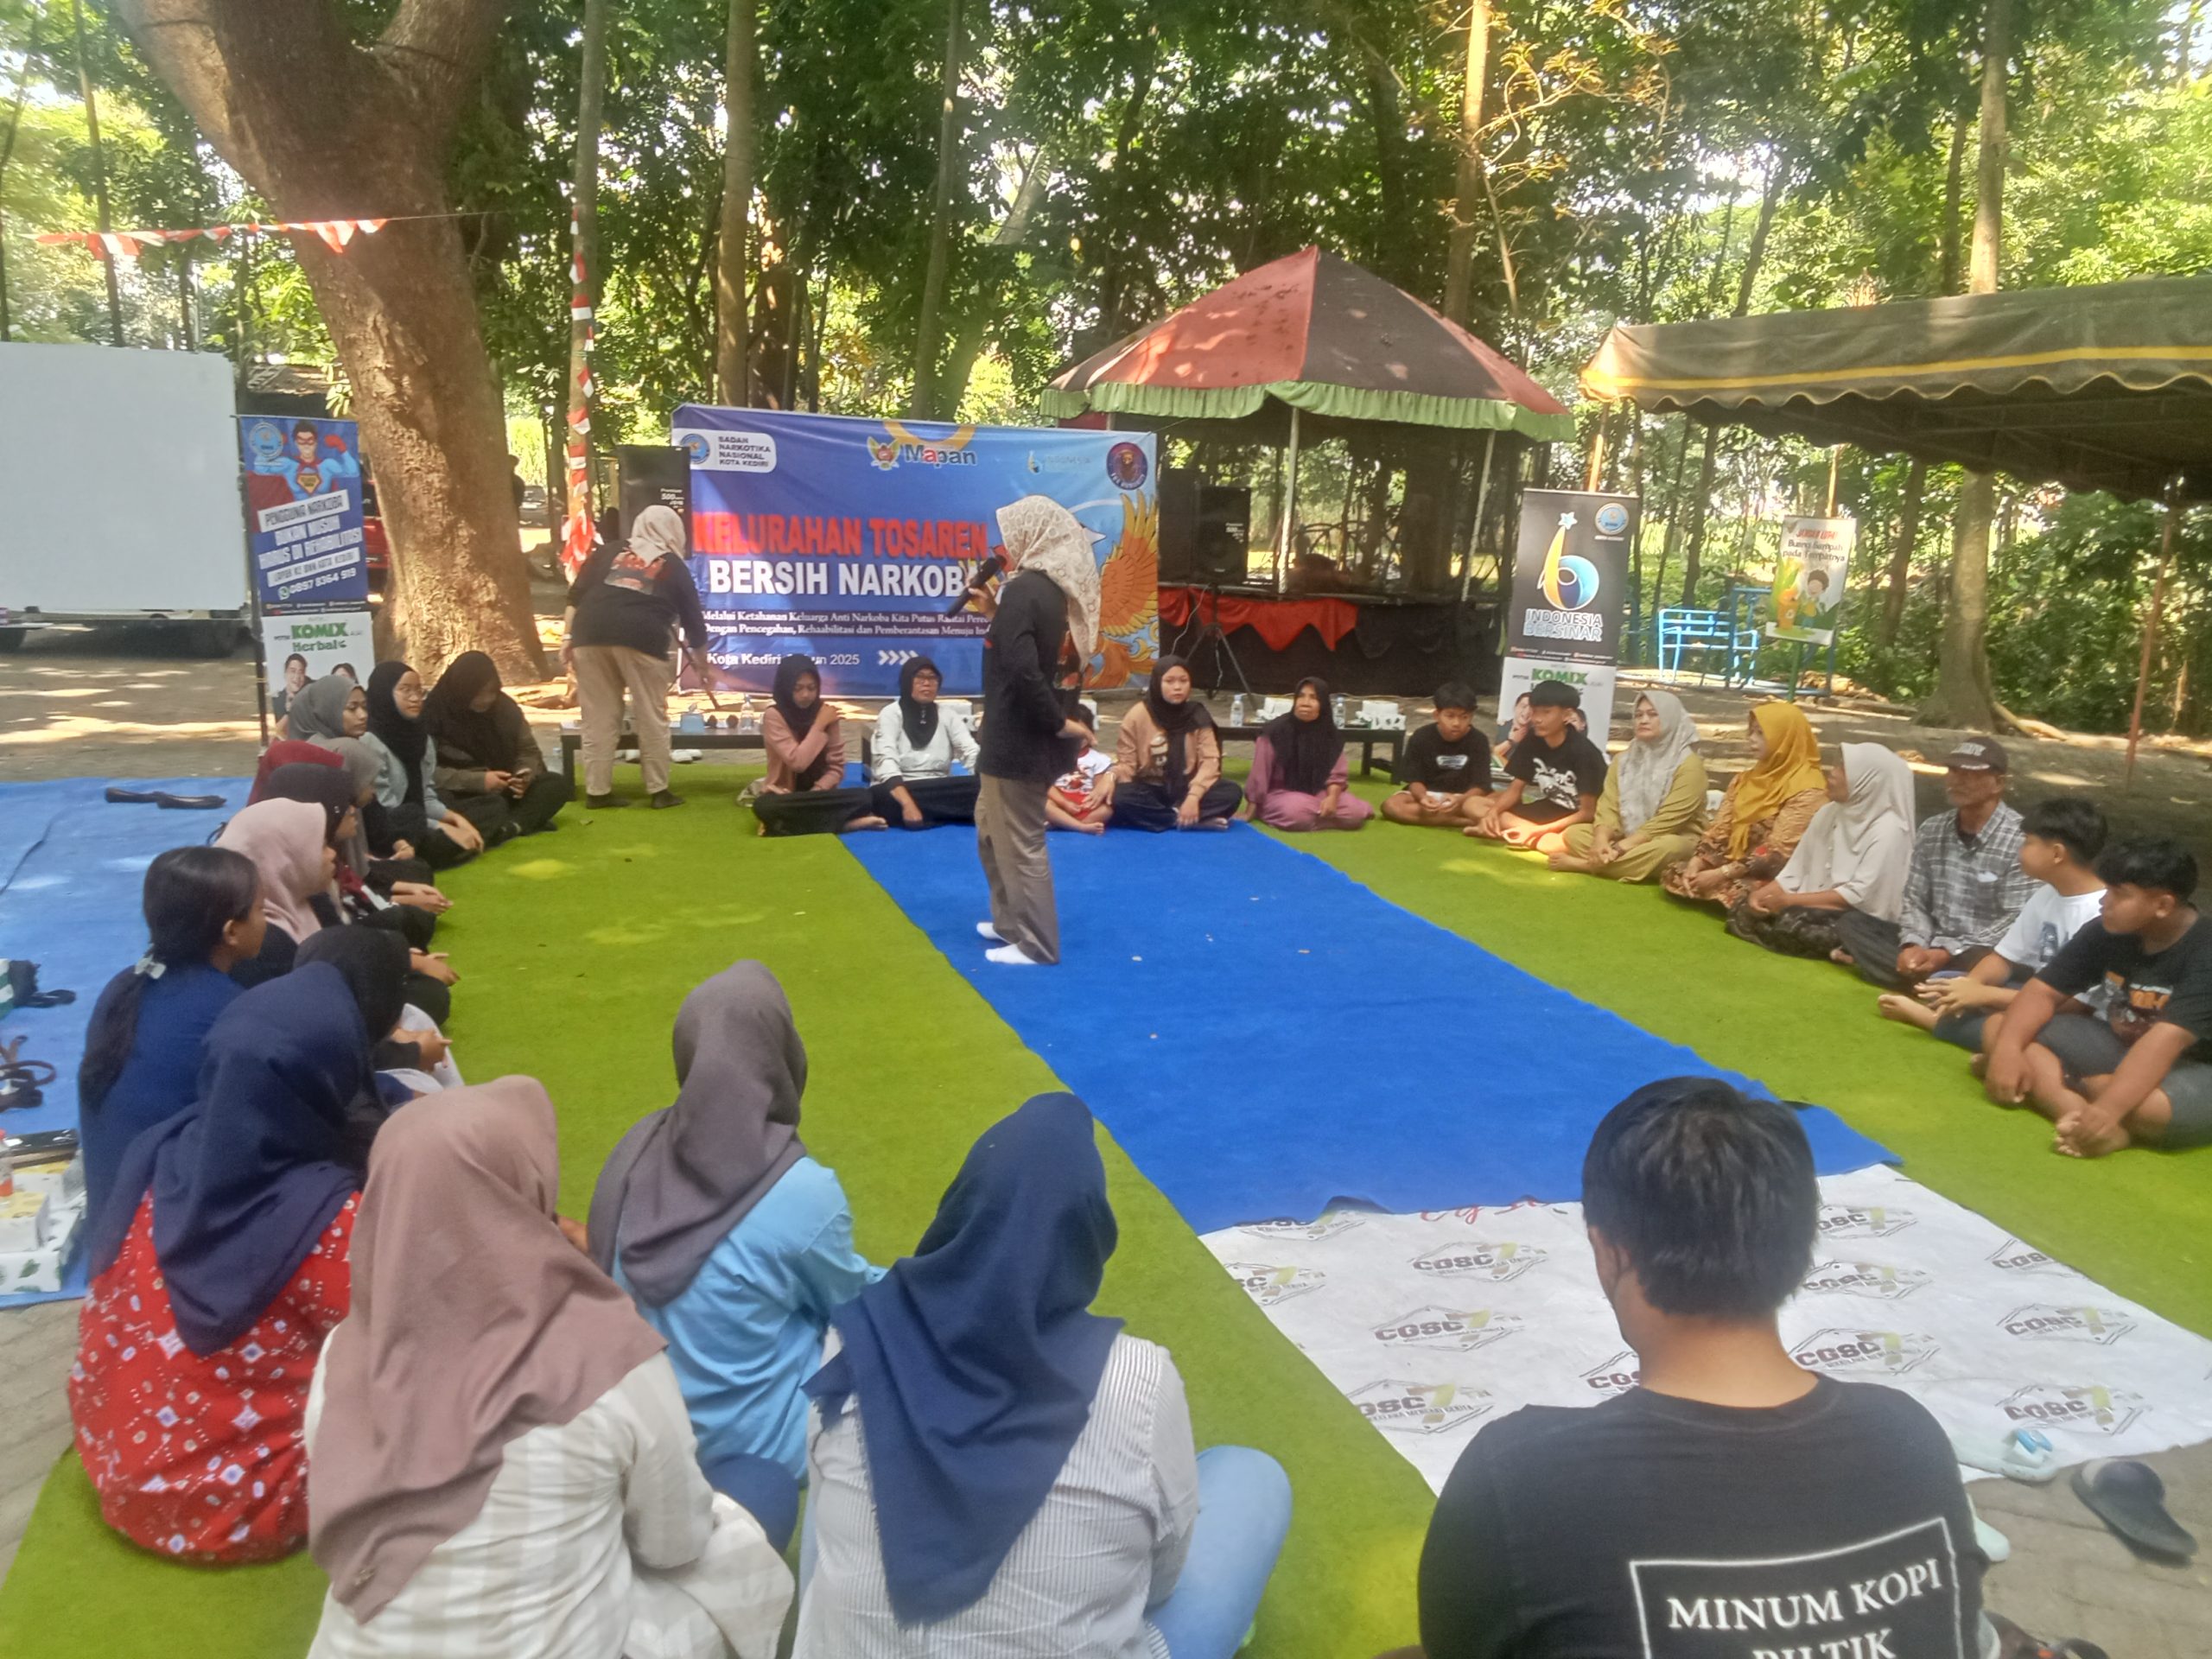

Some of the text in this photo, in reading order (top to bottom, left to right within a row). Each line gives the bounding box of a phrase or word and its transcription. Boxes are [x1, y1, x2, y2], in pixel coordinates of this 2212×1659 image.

[719, 444, 771, 453] NARKOTIKA
[906, 444, 977, 467] Mapan
[693, 512, 988, 560] KELURAHAN TOSAREN
[709, 560, 828, 594] BERSIH
[738, 611, 787, 620] Ketahanan
[789, 612, 829, 622] Keluarga
[830, 613, 850, 621] Anti
[852, 613, 889, 622] Narkoba
[892, 613, 909, 622] Kita
[912, 614, 935, 623] Putus
[1525, 608, 1604, 627] INDONESIA
[291, 622, 349, 639] KOMIX
[856, 626, 872, 634] dan
[874, 626, 939, 635] Pemberantasan
[941, 626, 974, 636] Menuju
[1522, 622, 1602, 642] BERSINAR
[292, 639, 338, 652] Herbal
[707, 653, 738, 664] Kota
[741, 653, 782, 664] Kediri
[830, 654, 860, 664] 2025
[1532, 668, 1588, 685] KOMIX
[1666, 1558, 1942, 1630] MINUM KOPI
